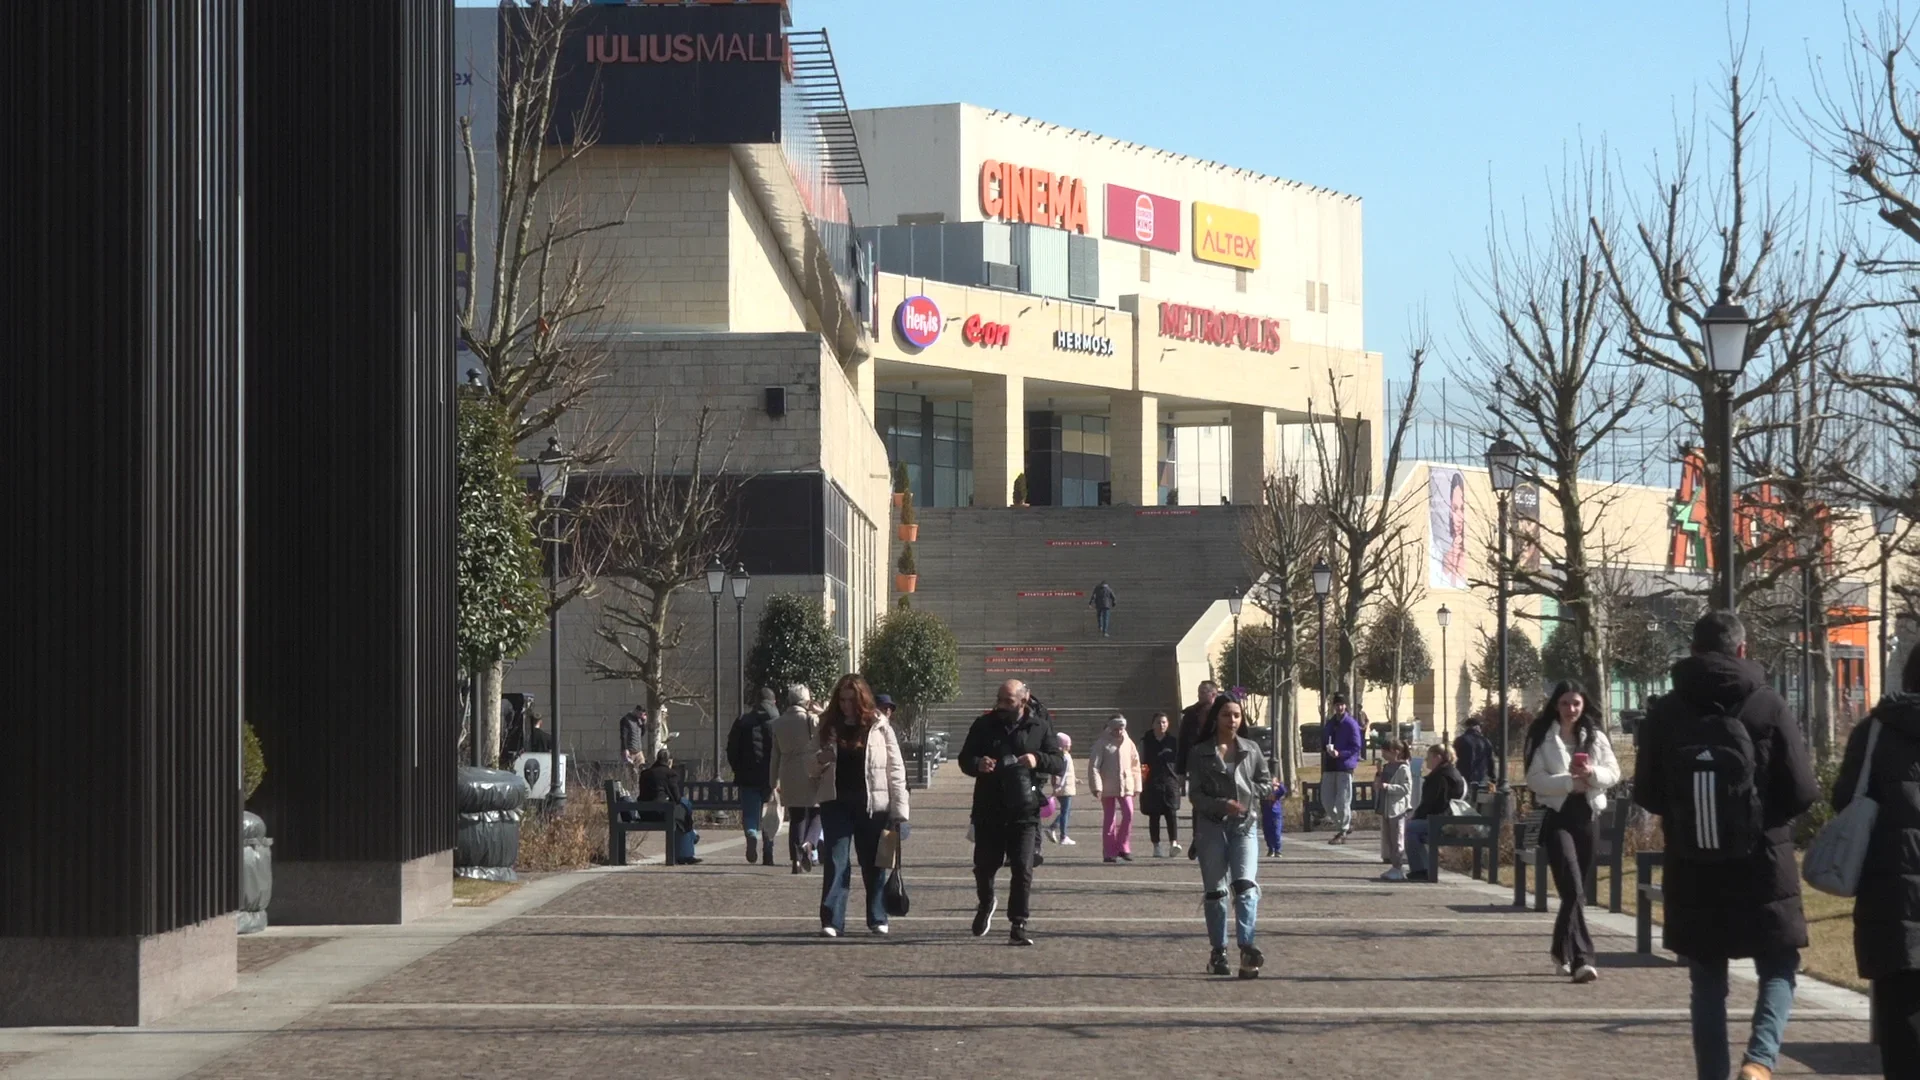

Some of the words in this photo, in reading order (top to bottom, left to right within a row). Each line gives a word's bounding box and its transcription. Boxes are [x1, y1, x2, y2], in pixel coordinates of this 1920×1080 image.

[981, 159, 1089, 235] CINEMA
[906, 305, 939, 336] Hervis
[1158, 302, 1280, 353] METROPOLIS
[1056, 330, 1113, 356] HERMOSA
